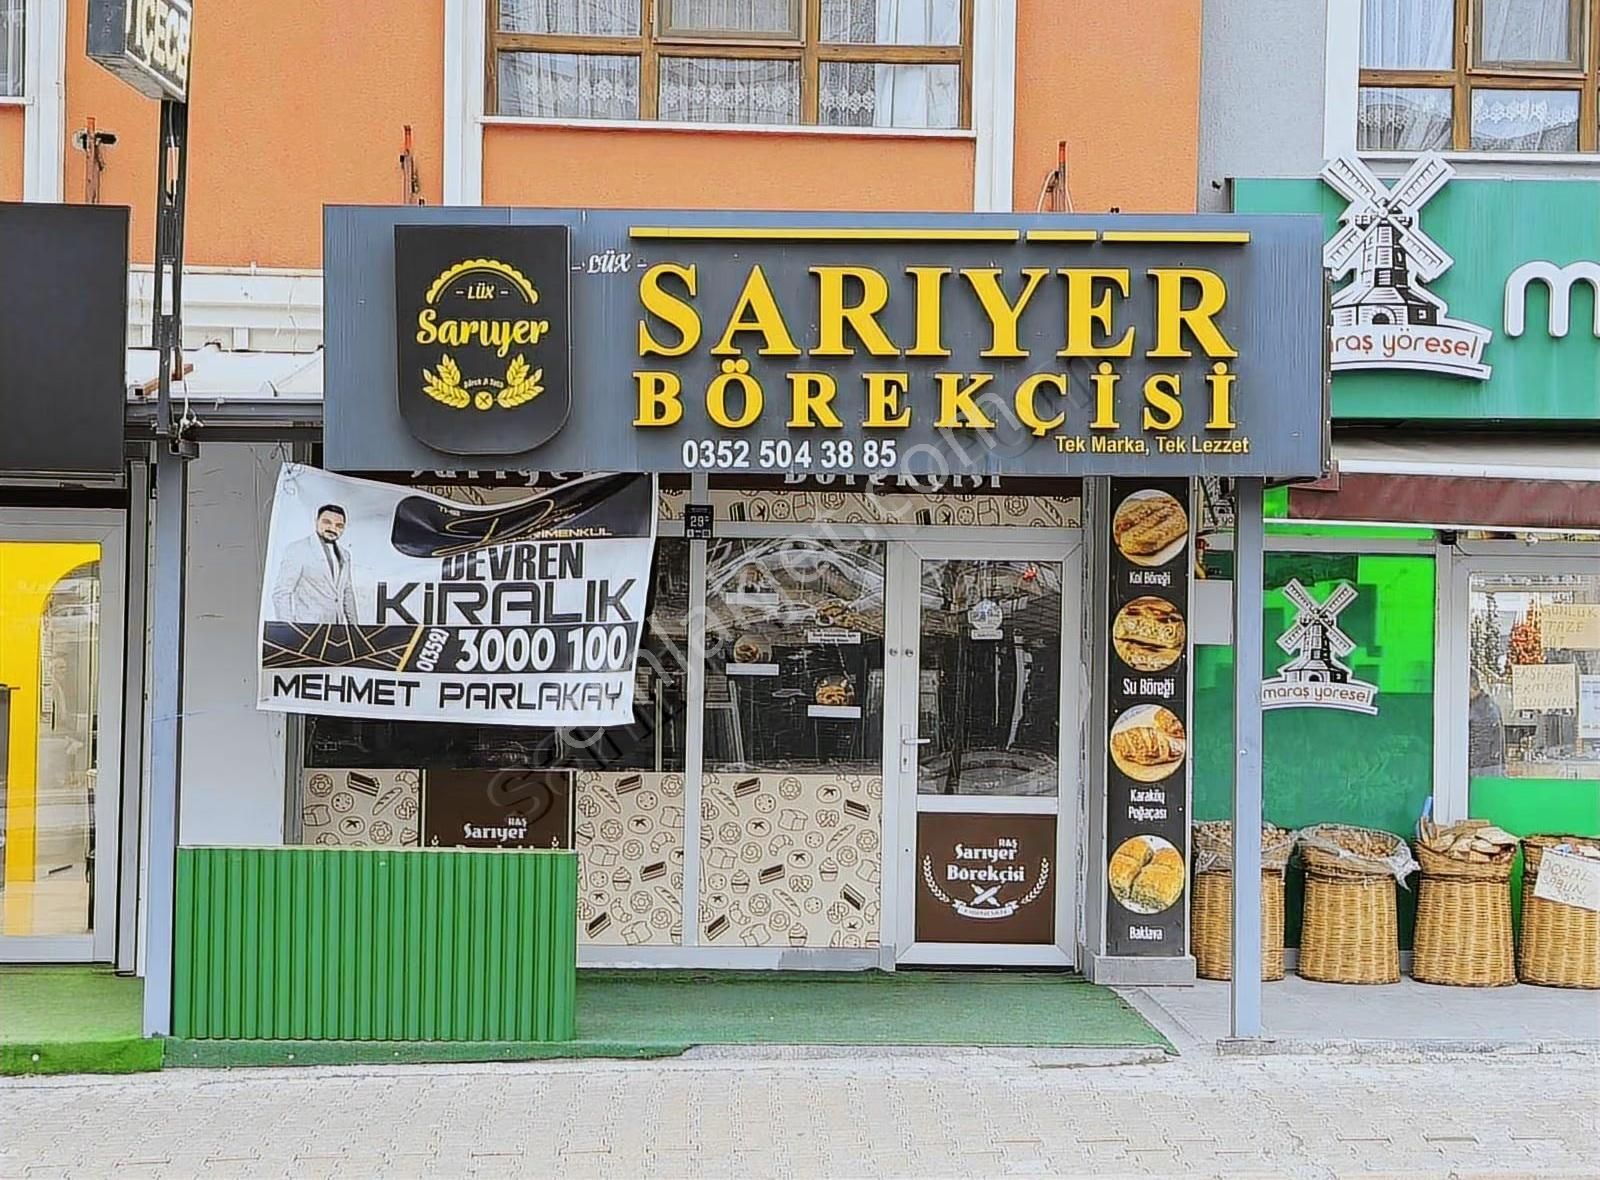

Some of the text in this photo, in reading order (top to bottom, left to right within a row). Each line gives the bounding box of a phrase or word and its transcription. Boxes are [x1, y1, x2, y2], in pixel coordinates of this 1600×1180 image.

[467, 283, 495, 299] LÜX
[639, 264, 1239, 357] SARIYER
[416, 308, 549, 358] Sarıyer
[1330, 328, 1478, 359] raş yöresel
[632, 359, 1237, 436] BÖREKÇİSİ
[682, 440, 896, 468] 0352 504 38 85
[1055, 435, 1249, 456] Tek Marka, Tek Lezzet
[441, 542, 584, 581] DEVREN
[1129, 571, 1143, 584] Kol
[455, 628, 556, 672] 3000
[567, 627, 628, 672] 100
[273, 675, 623, 711] MEHMET PARLAKAY
[1123, 678, 1174, 698] Su Böreği
[1263, 687, 1310, 699] maraş
[1130, 789, 1165, 804] Karaköy
[463, 823, 527, 842] Sarıyer
[955, 843, 1018, 863] Sarıyer
